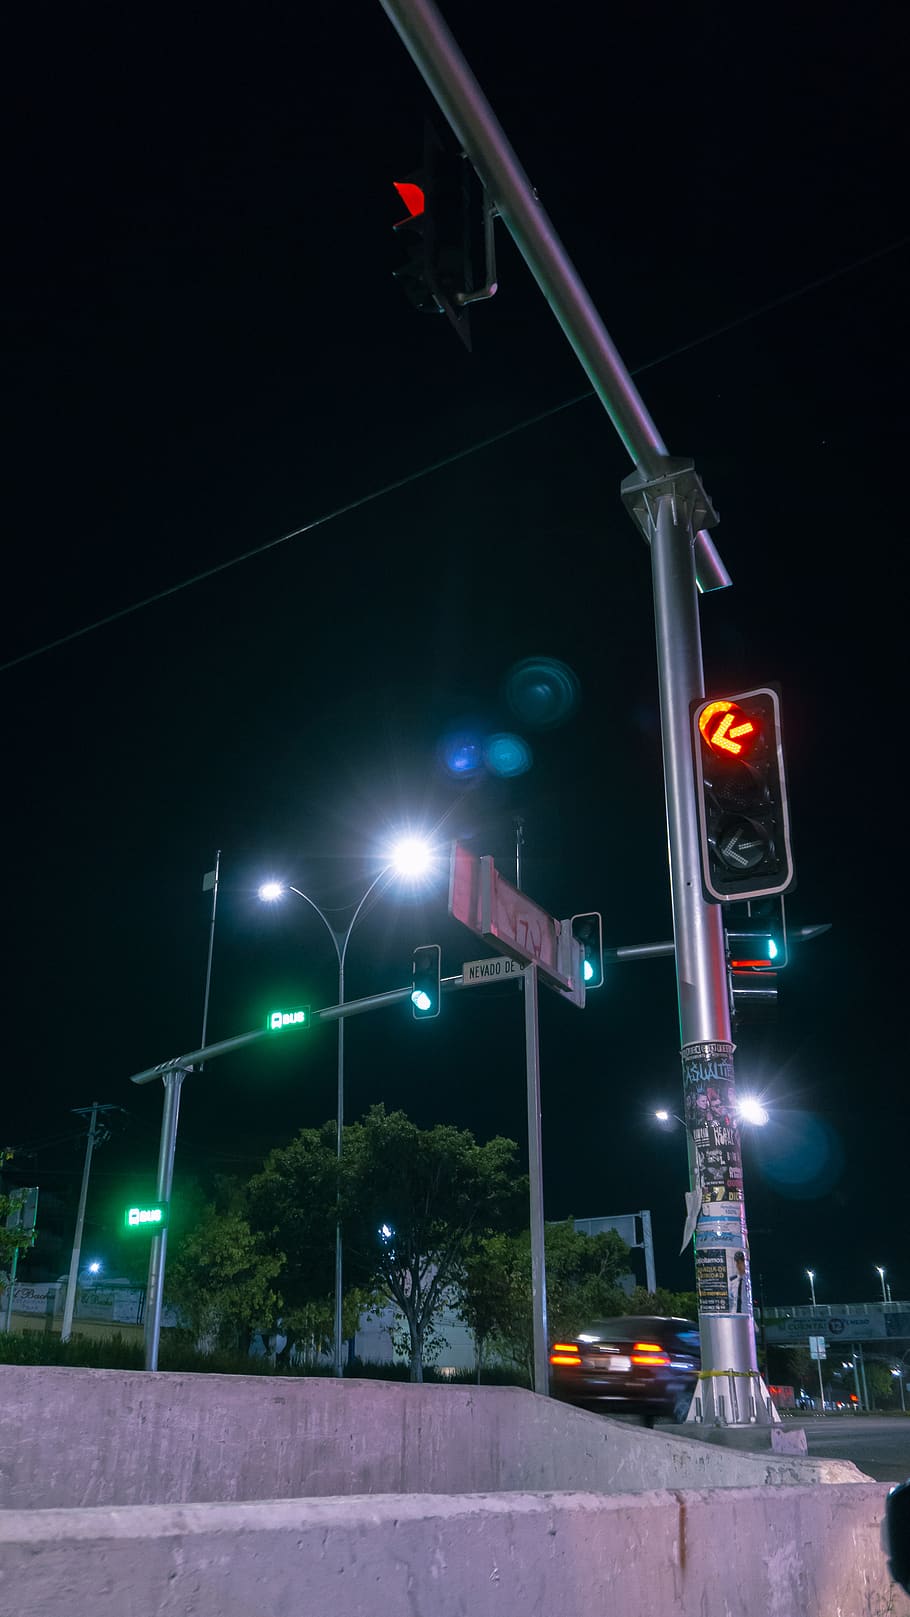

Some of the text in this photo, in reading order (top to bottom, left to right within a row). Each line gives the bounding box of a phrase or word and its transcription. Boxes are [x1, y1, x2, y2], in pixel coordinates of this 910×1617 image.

[469, 962, 501, 979] NEVADO
[505, 960, 515, 973] DE
[282, 1011, 305, 1025] BUS
[712, 1186, 726, 1201] 7
